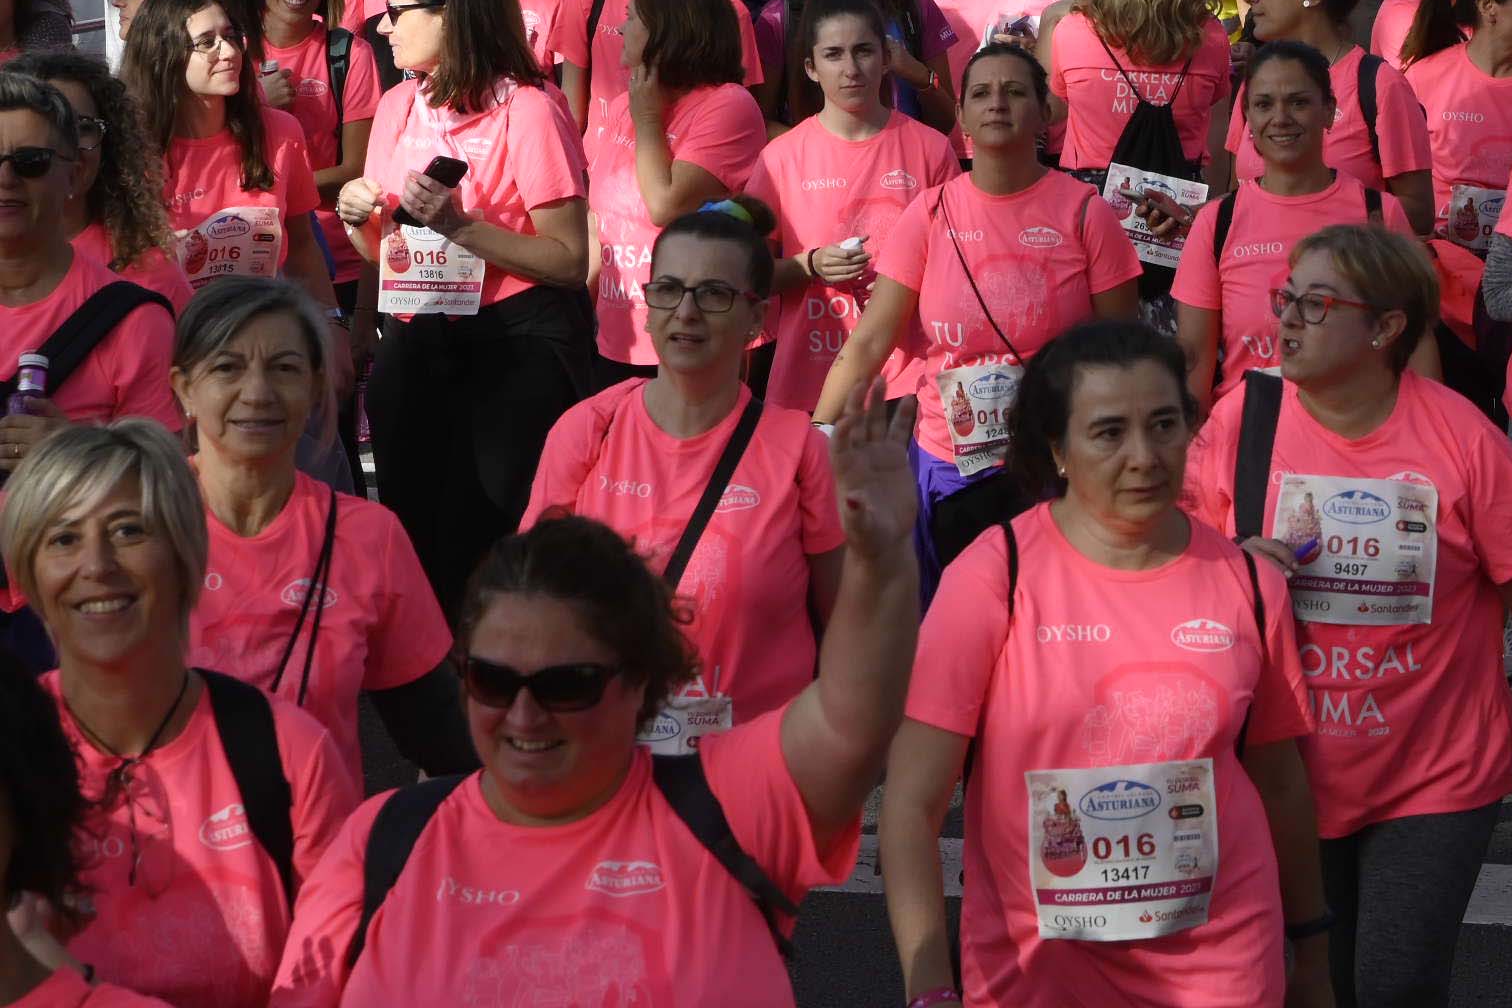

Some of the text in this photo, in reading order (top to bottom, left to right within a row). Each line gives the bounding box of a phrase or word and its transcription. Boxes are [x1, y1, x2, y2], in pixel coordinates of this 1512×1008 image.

[1146, 84, 1168, 100] LA
[1441, 110, 1485, 123] OYSHO
[801, 177, 848, 192] OYSHO
[208, 246, 241, 262] 016
[413, 250, 448, 265] 016
[1232, 242, 1283, 258] OYSHO
[418, 269, 444, 280] 13816
[931, 320, 964, 347] TU
[1326, 502, 1386, 518] ASTURIANA
[1327, 534, 1381, 558] 016
[1333, 562, 1368, 577] 9497
[1333, 581, 1347, 591] DE
[1348, 582, 1360, 591] LA
[1361, 583, 1393, 592] MUJER
[1293, 599, 1331, 612] YSHO
[1037, 623, 1112, 643] OYSHO
[1175, 630, 1232, 645] ASTURIANA
[1303, 642, 1422, 680] ORSAL
[1167, 783, 1200, 794] SUMA
[1085, 795, 1158, 813] ASTURIANA
[1092, 833, 1157, 860] 016
[1100, 865, 1151, 884] 13417
[1054, 891, 1105, 903] CARRERA
[1107, 890, 1124, 901] DE
[1124, 888, 1138, 900] LA
[1141, 886, 1177, 898] MUJER
[1054, 914, 1107, 929] OYSHO
